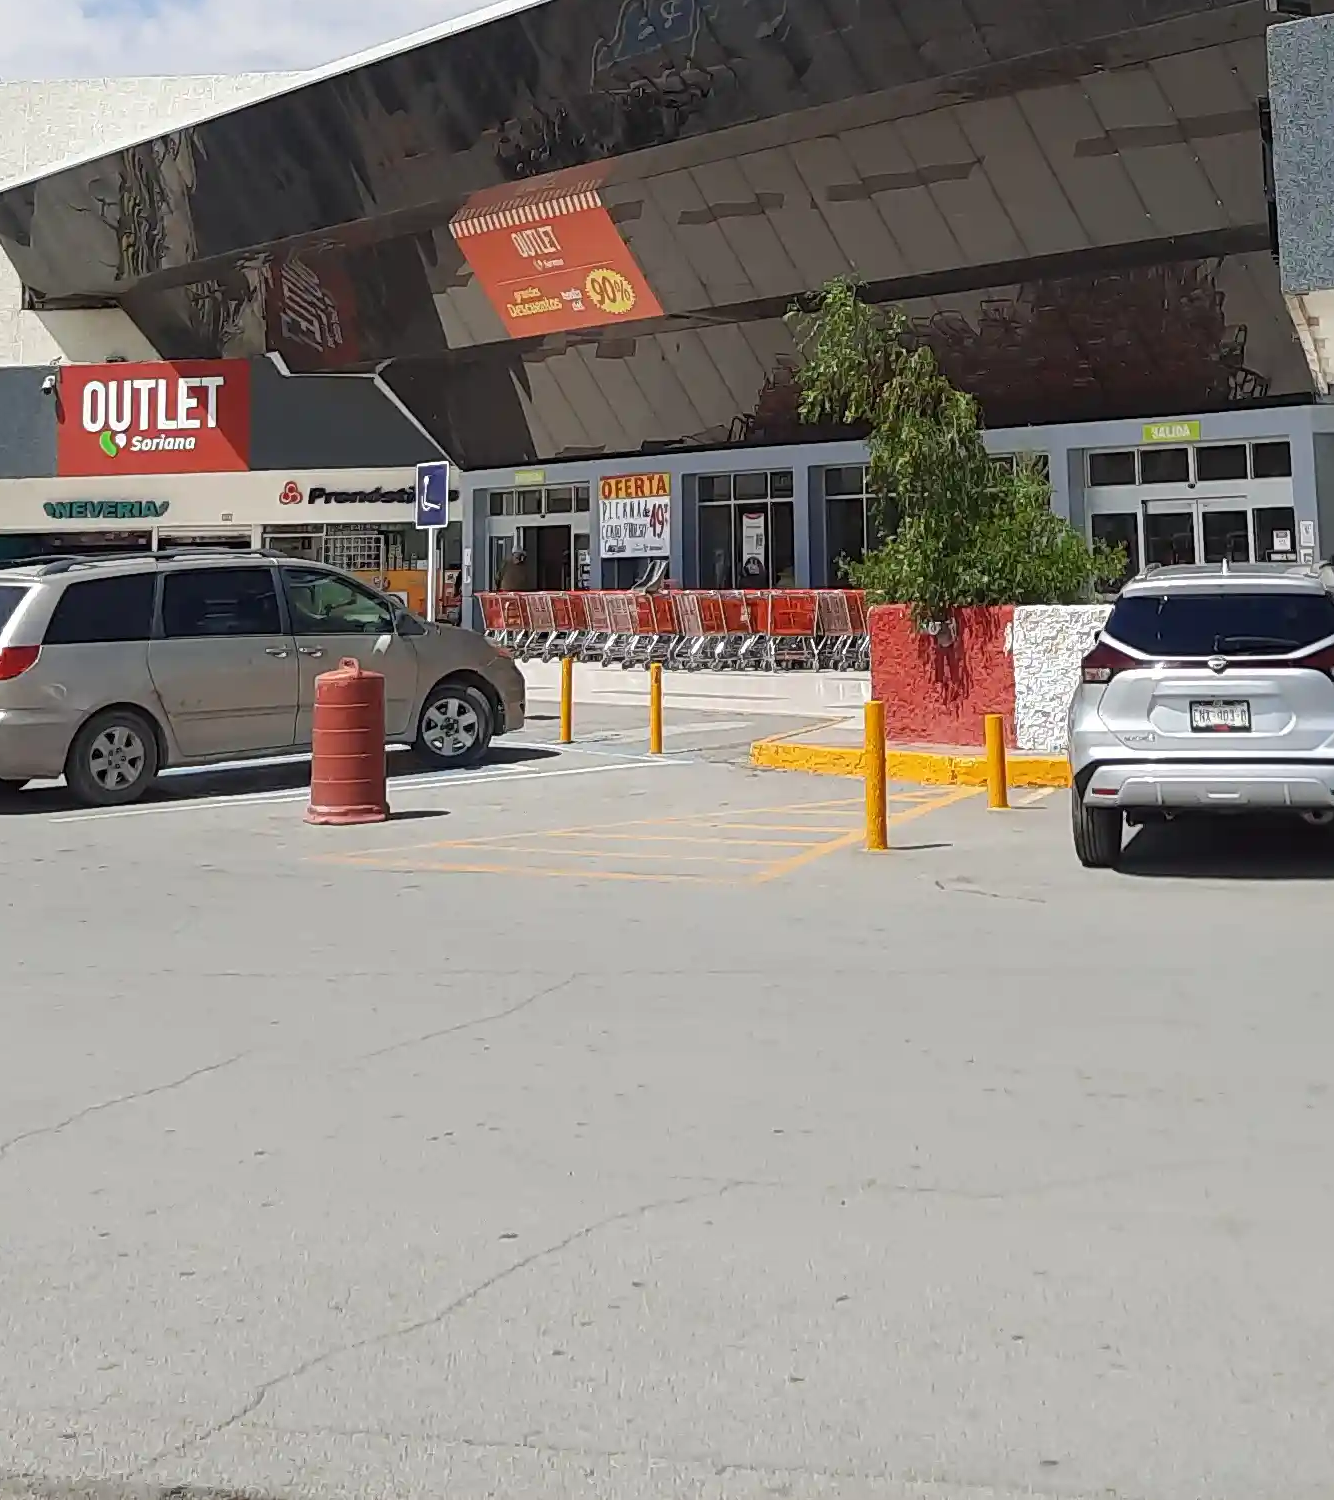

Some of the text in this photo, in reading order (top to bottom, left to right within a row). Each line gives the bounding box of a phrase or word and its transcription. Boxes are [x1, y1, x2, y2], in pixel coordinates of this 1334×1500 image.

[511, 226, 562, 257] OUTLET
[591, 276, 631, 304] 90%
[82, 377, 224, 432] OUTLET
[130, 434, 196, 451] Soriana
[1151, 424, 1191, 439] SALIDA
[602, 474, 667, 499] OFERTA
[52, 501, 160, 518] NEVERIA
